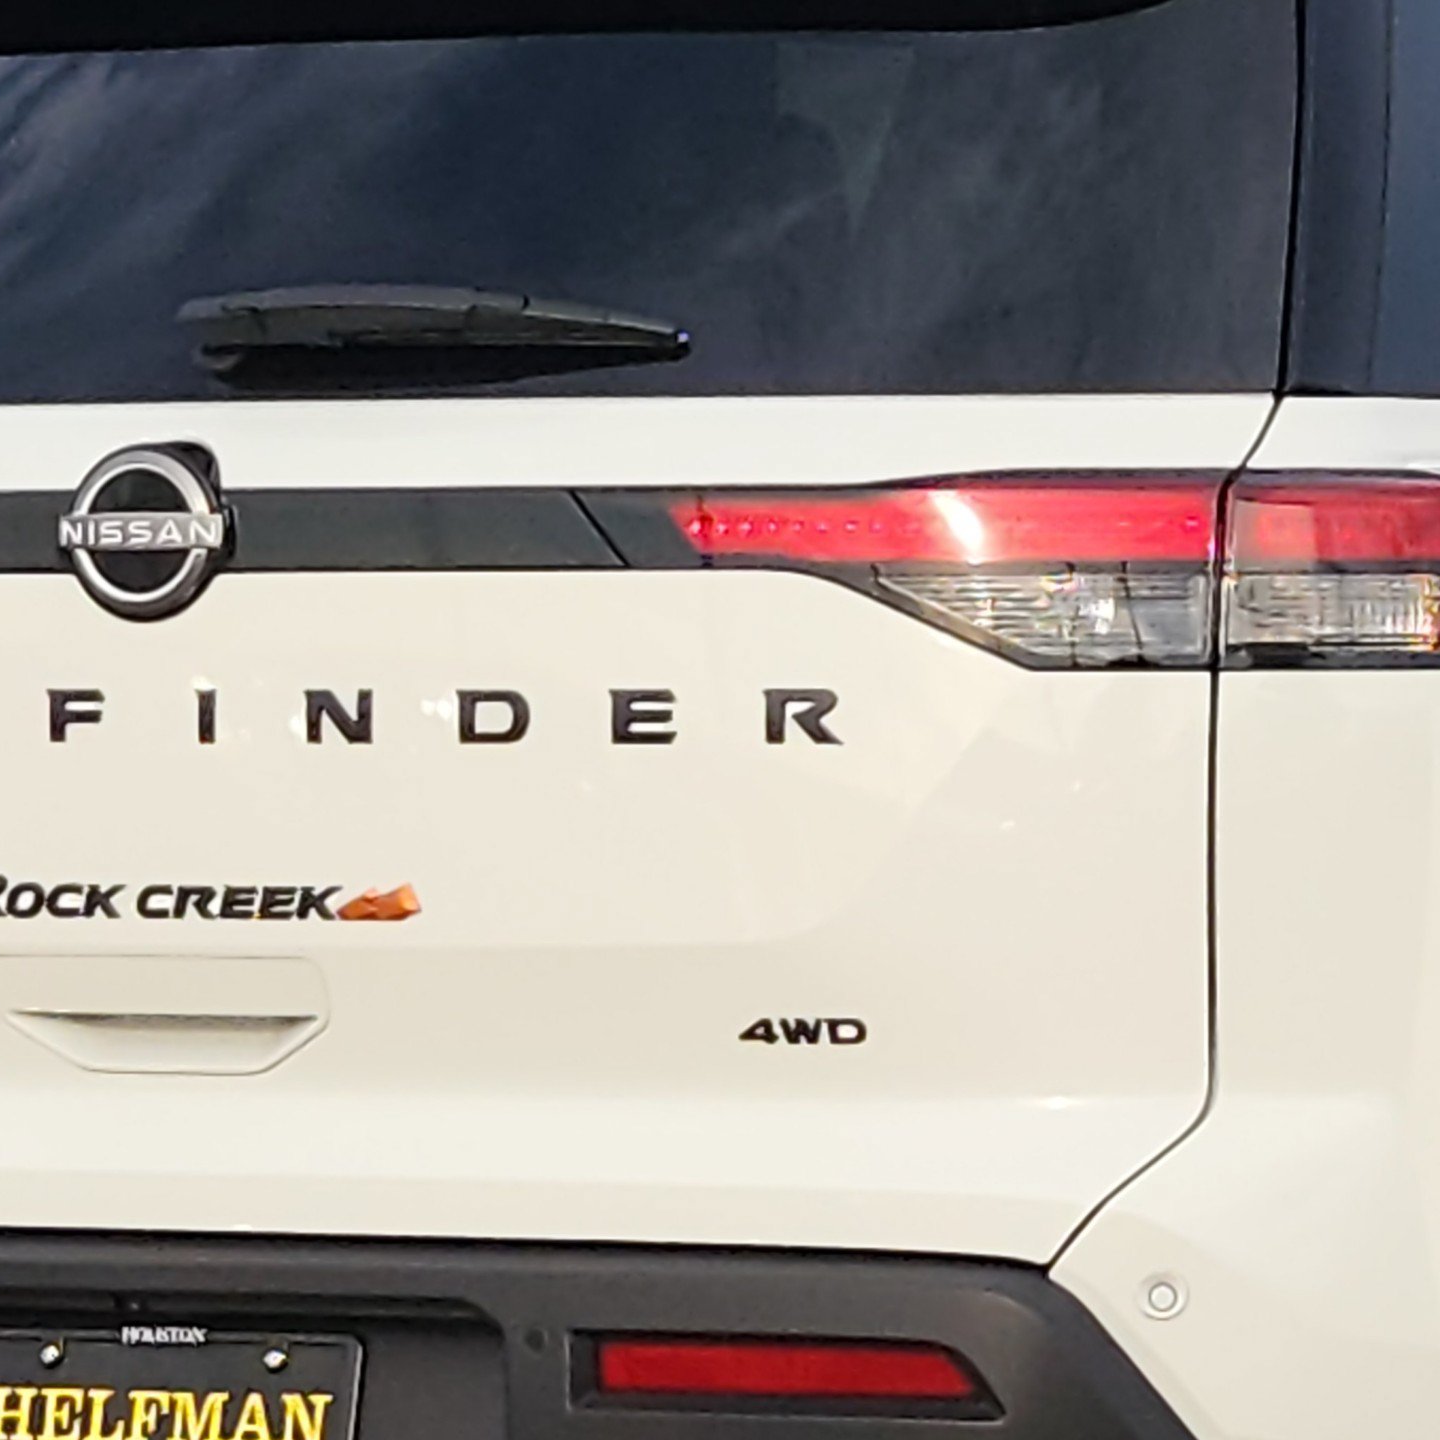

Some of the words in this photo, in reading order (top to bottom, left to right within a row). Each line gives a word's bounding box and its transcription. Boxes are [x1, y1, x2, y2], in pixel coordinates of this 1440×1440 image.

[61, 519, 217, 547] NISSAN
[136, 885, 343, 921] CREEK
[739, 1018, 867, 1045] 4WD
